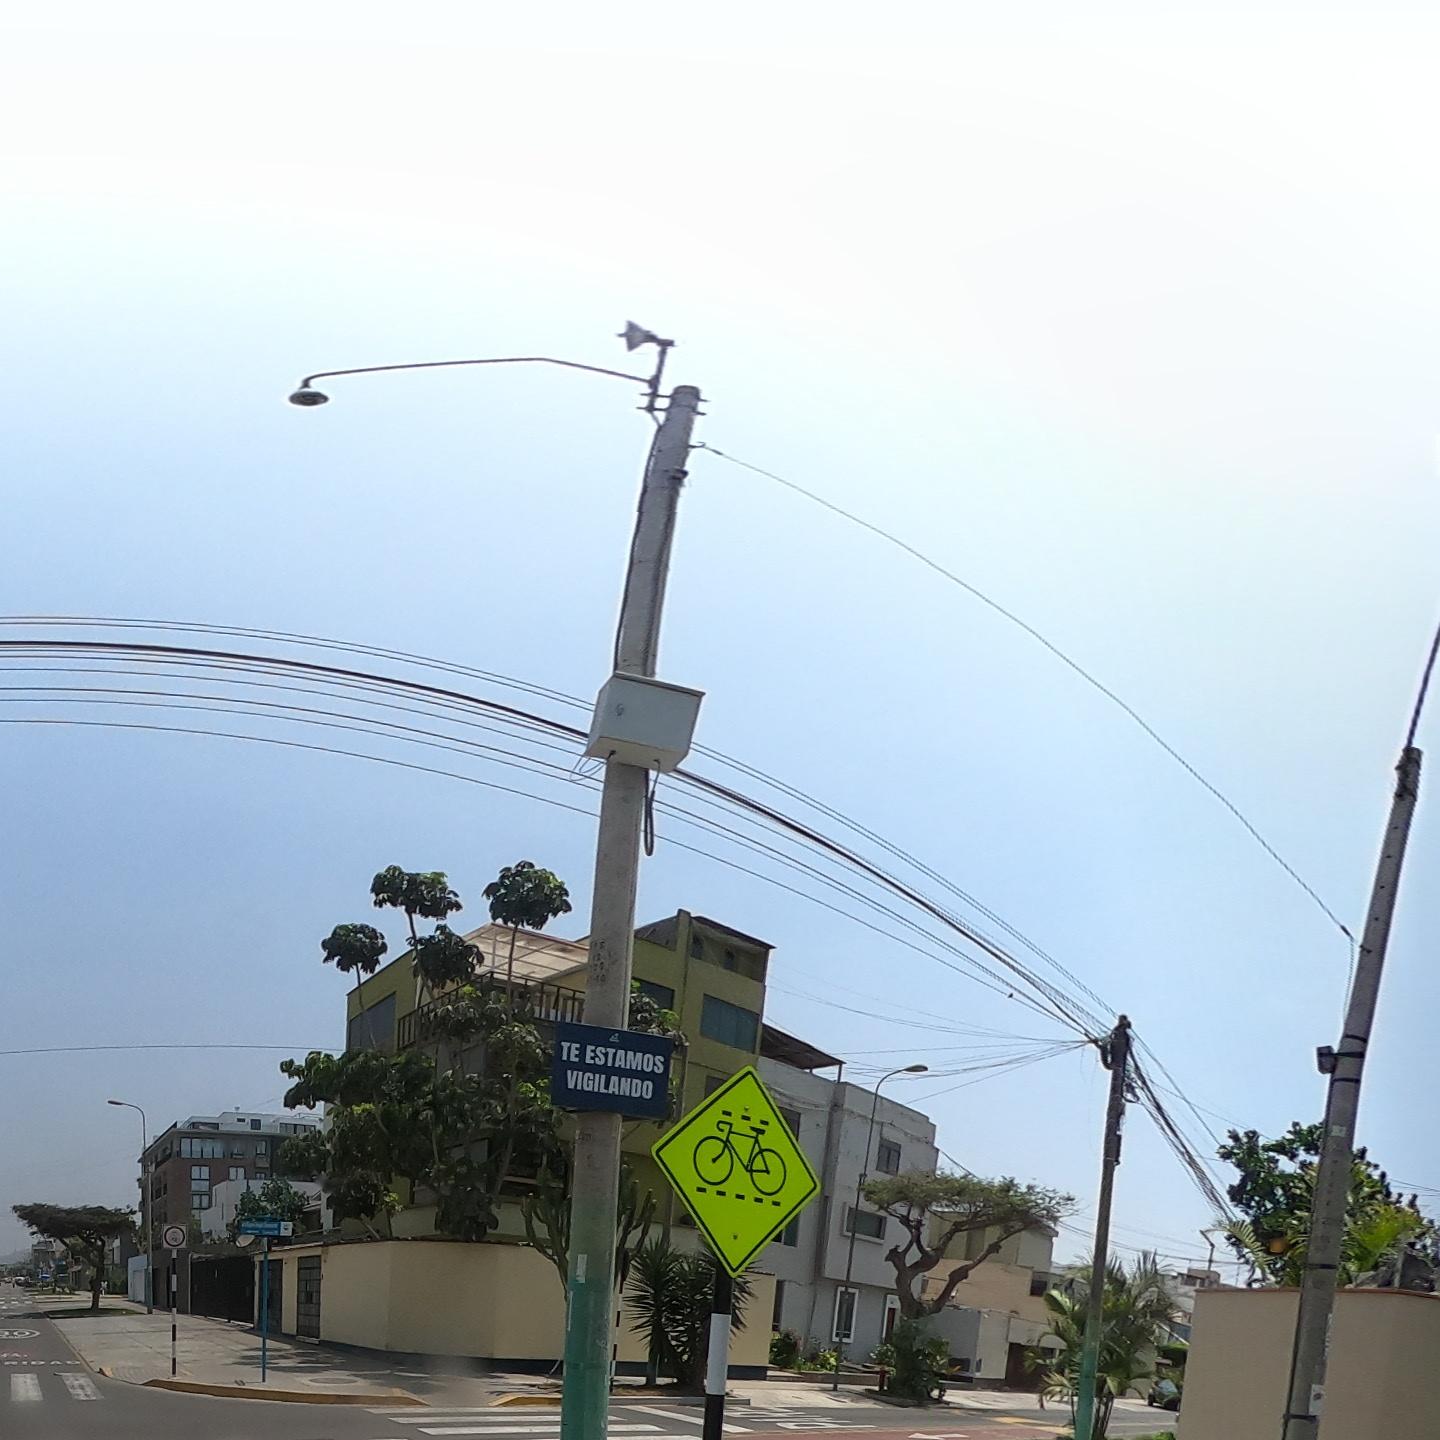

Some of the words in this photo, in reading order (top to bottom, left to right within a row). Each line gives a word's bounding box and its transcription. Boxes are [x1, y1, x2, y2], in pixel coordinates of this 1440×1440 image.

[561, 1042, 580, 1062] TE
[585, 1045, 665, 1074] ESTAMOS
[566, 1069, 653, 1099] VIGILANDO
